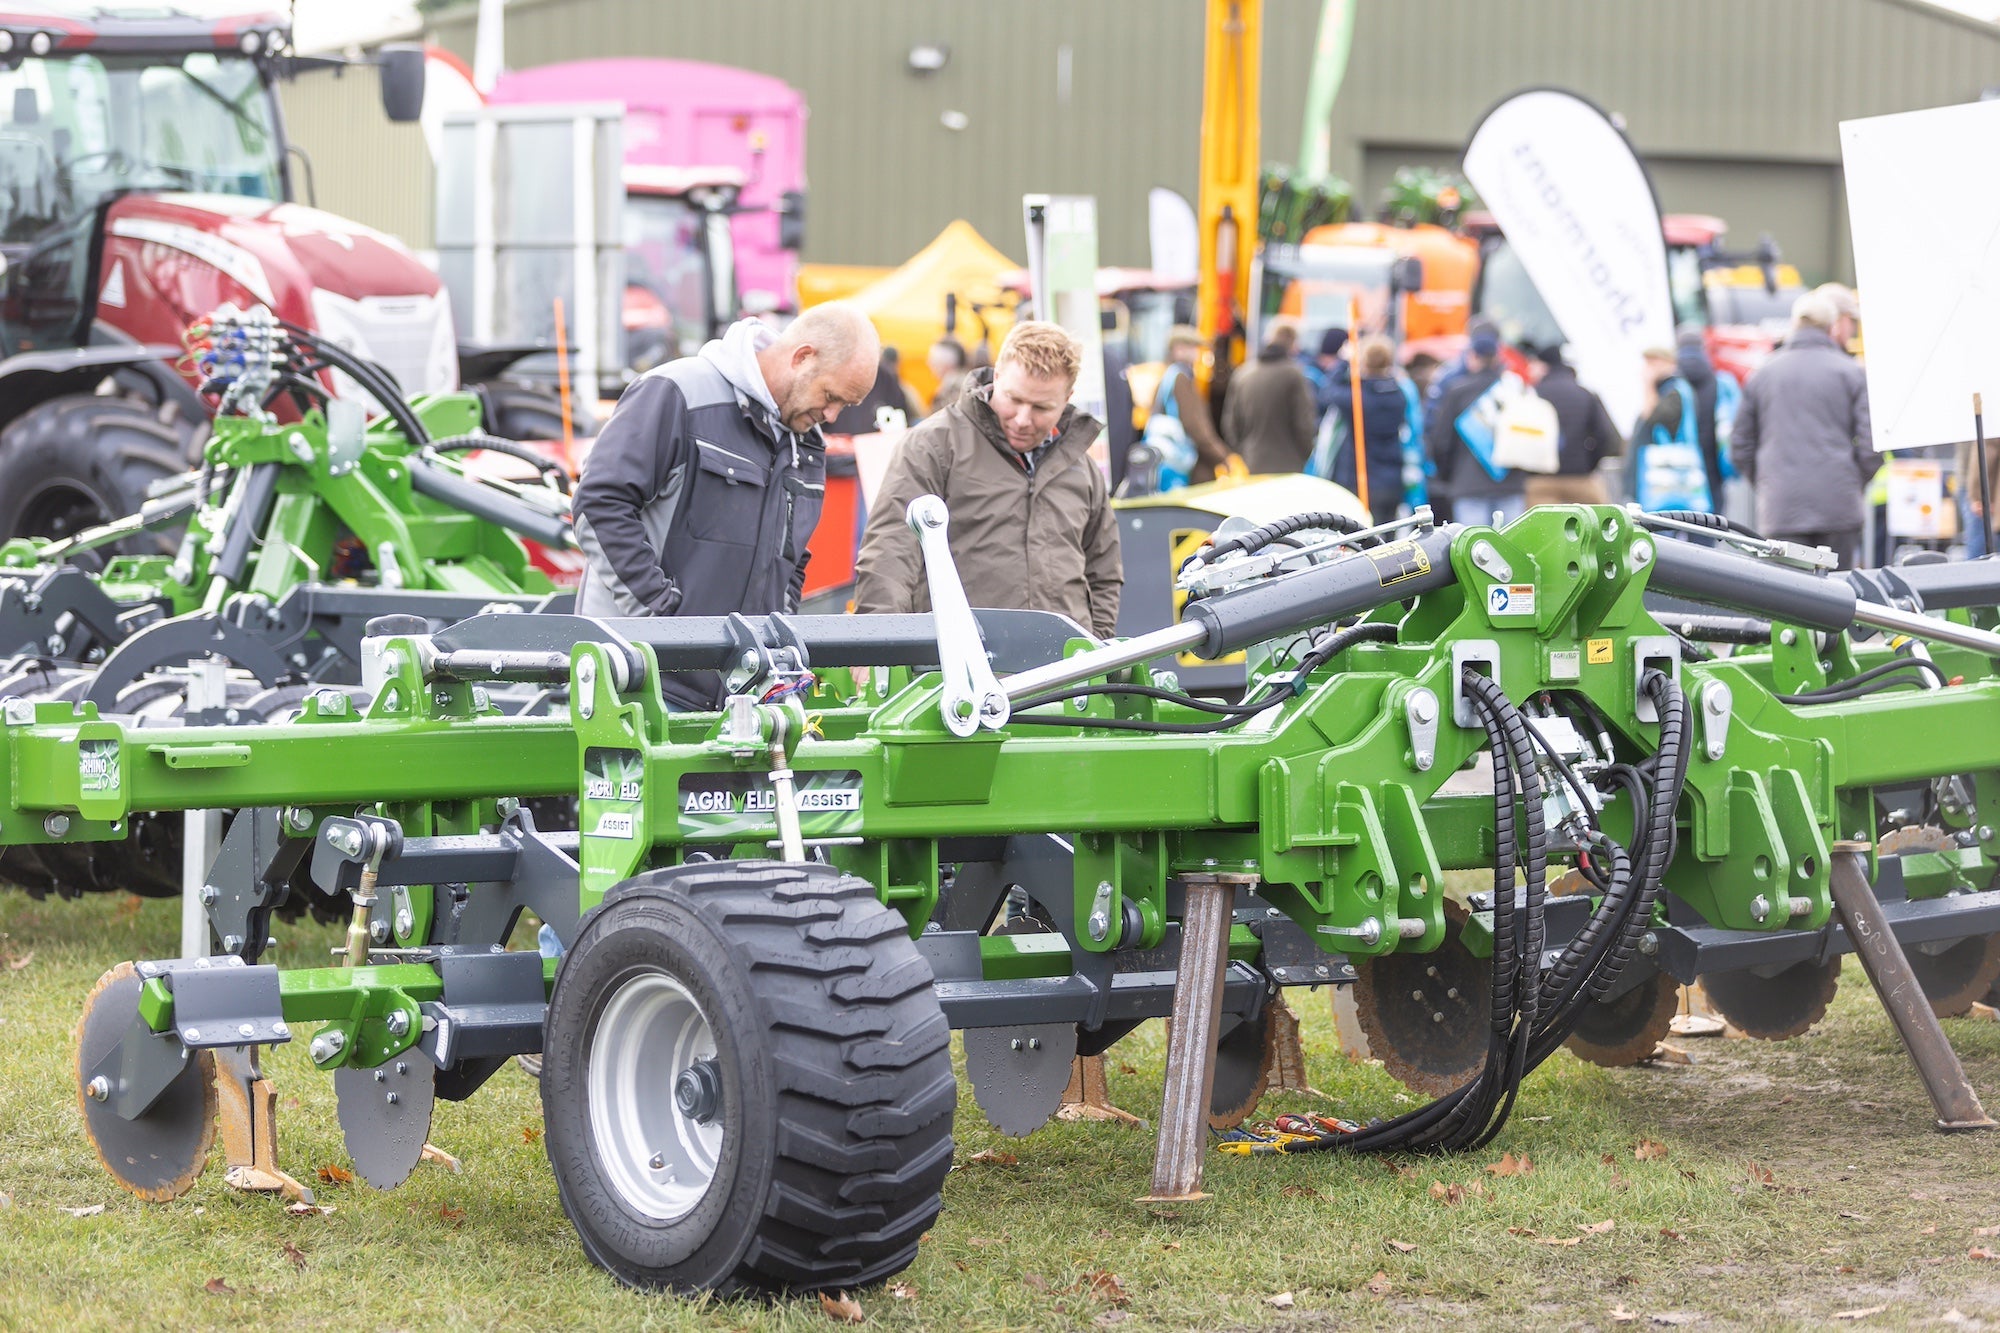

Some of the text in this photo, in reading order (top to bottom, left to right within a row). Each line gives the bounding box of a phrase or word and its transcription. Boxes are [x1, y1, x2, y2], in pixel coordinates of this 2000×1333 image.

[83, 758, 107, 774] RHINO
[801, 794, 852, 807] ASSIST
[602, 820, 630, 831] ASSIST
